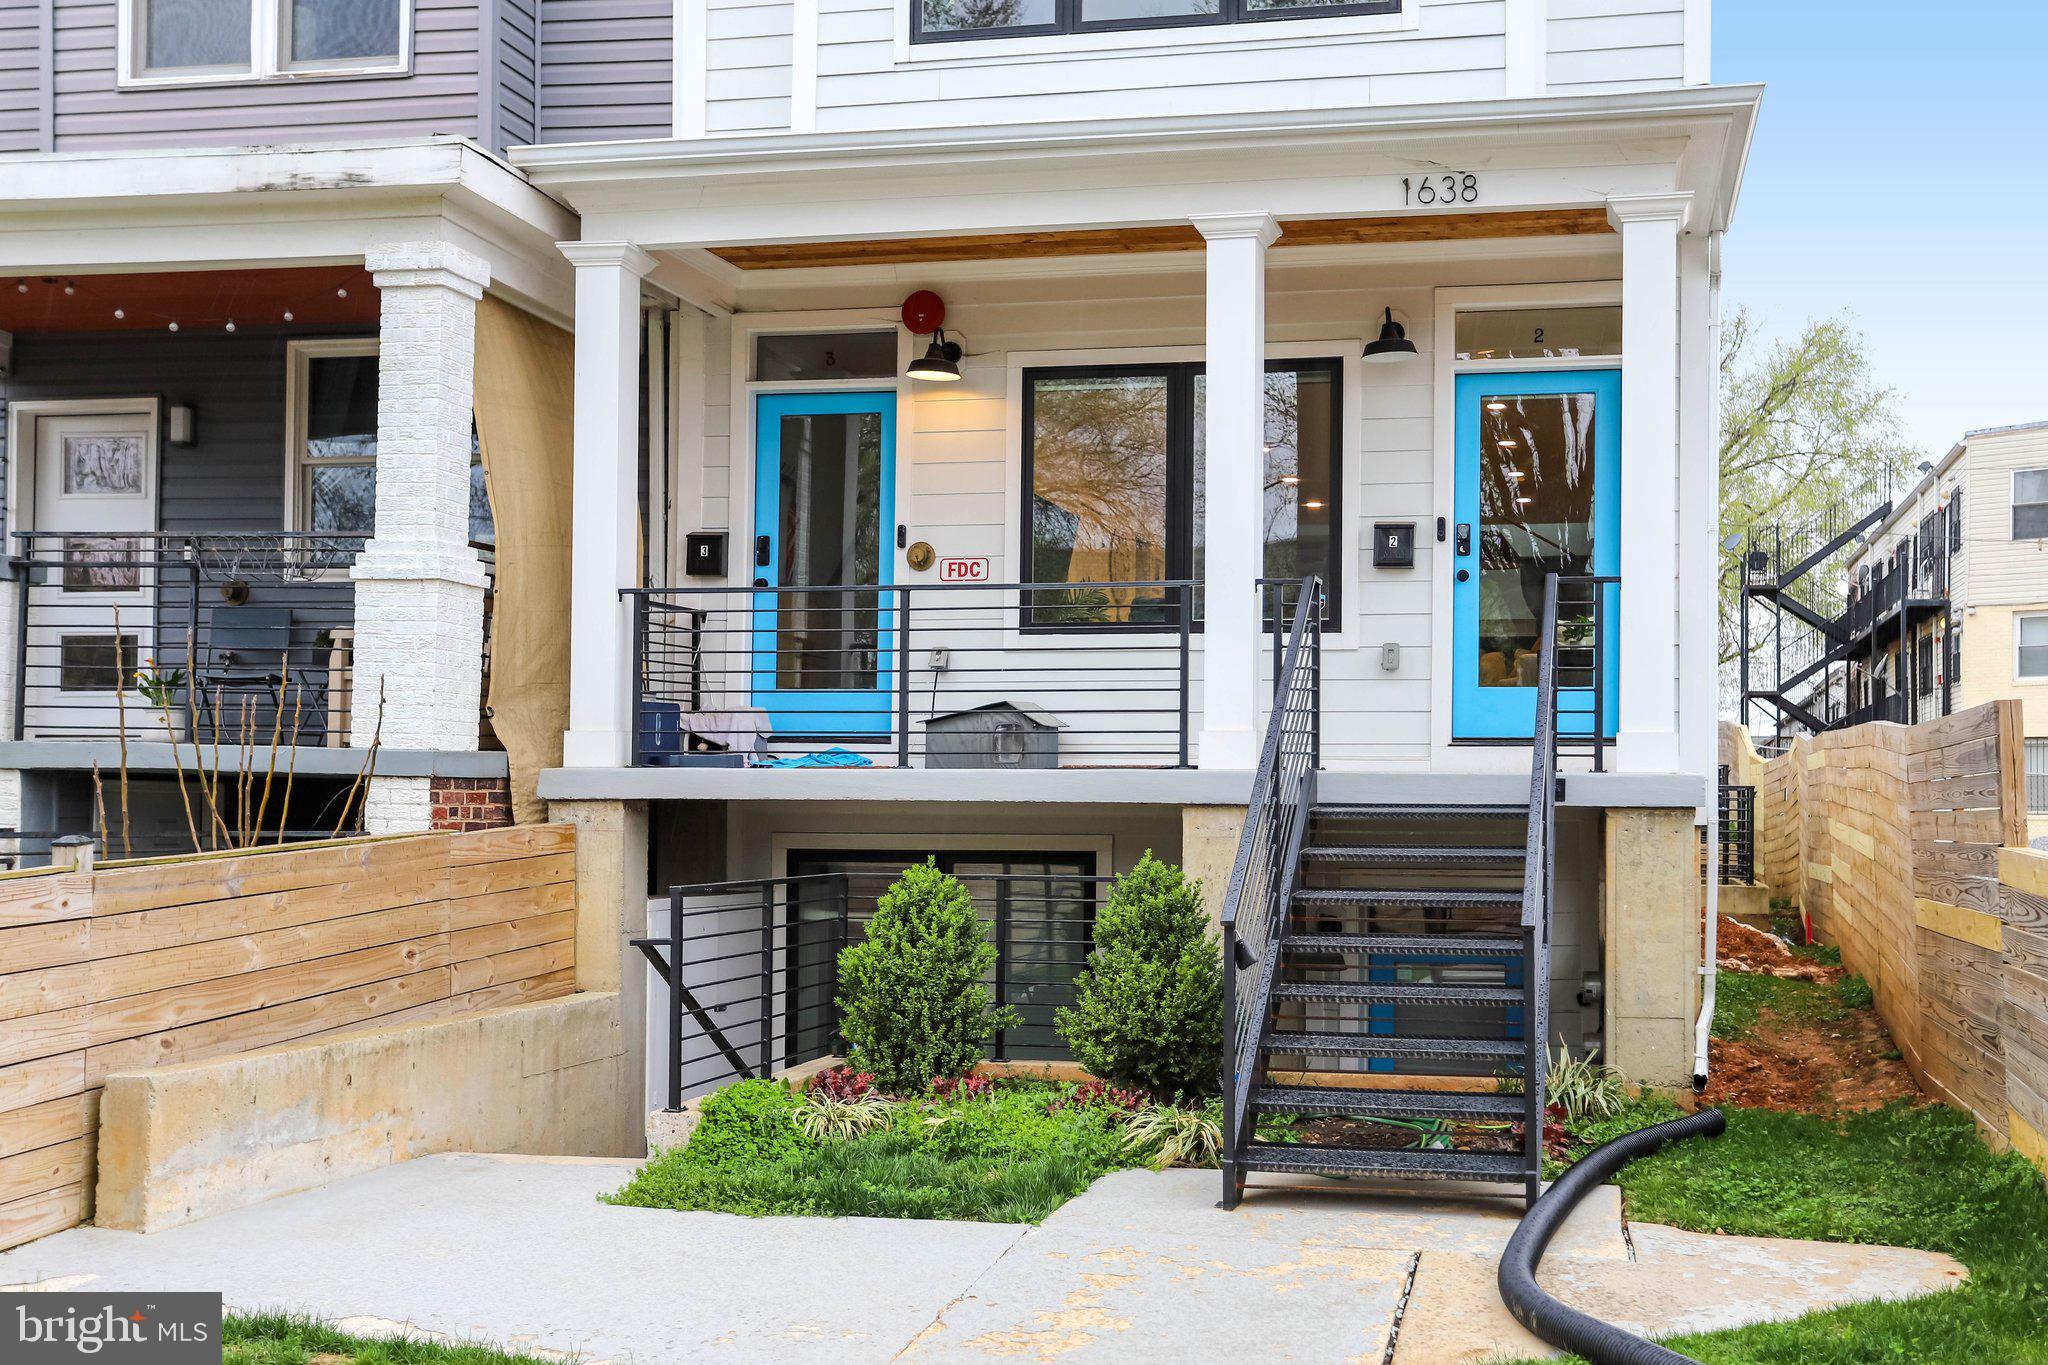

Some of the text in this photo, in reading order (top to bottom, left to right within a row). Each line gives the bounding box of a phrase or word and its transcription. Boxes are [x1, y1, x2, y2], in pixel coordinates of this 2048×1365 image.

[1400, 174, 1478, 206] 1638
[1534, 328, 1544, 343] 2
[825, 351, 836, 366] 3
[948, 561, 981, 578] FDC
